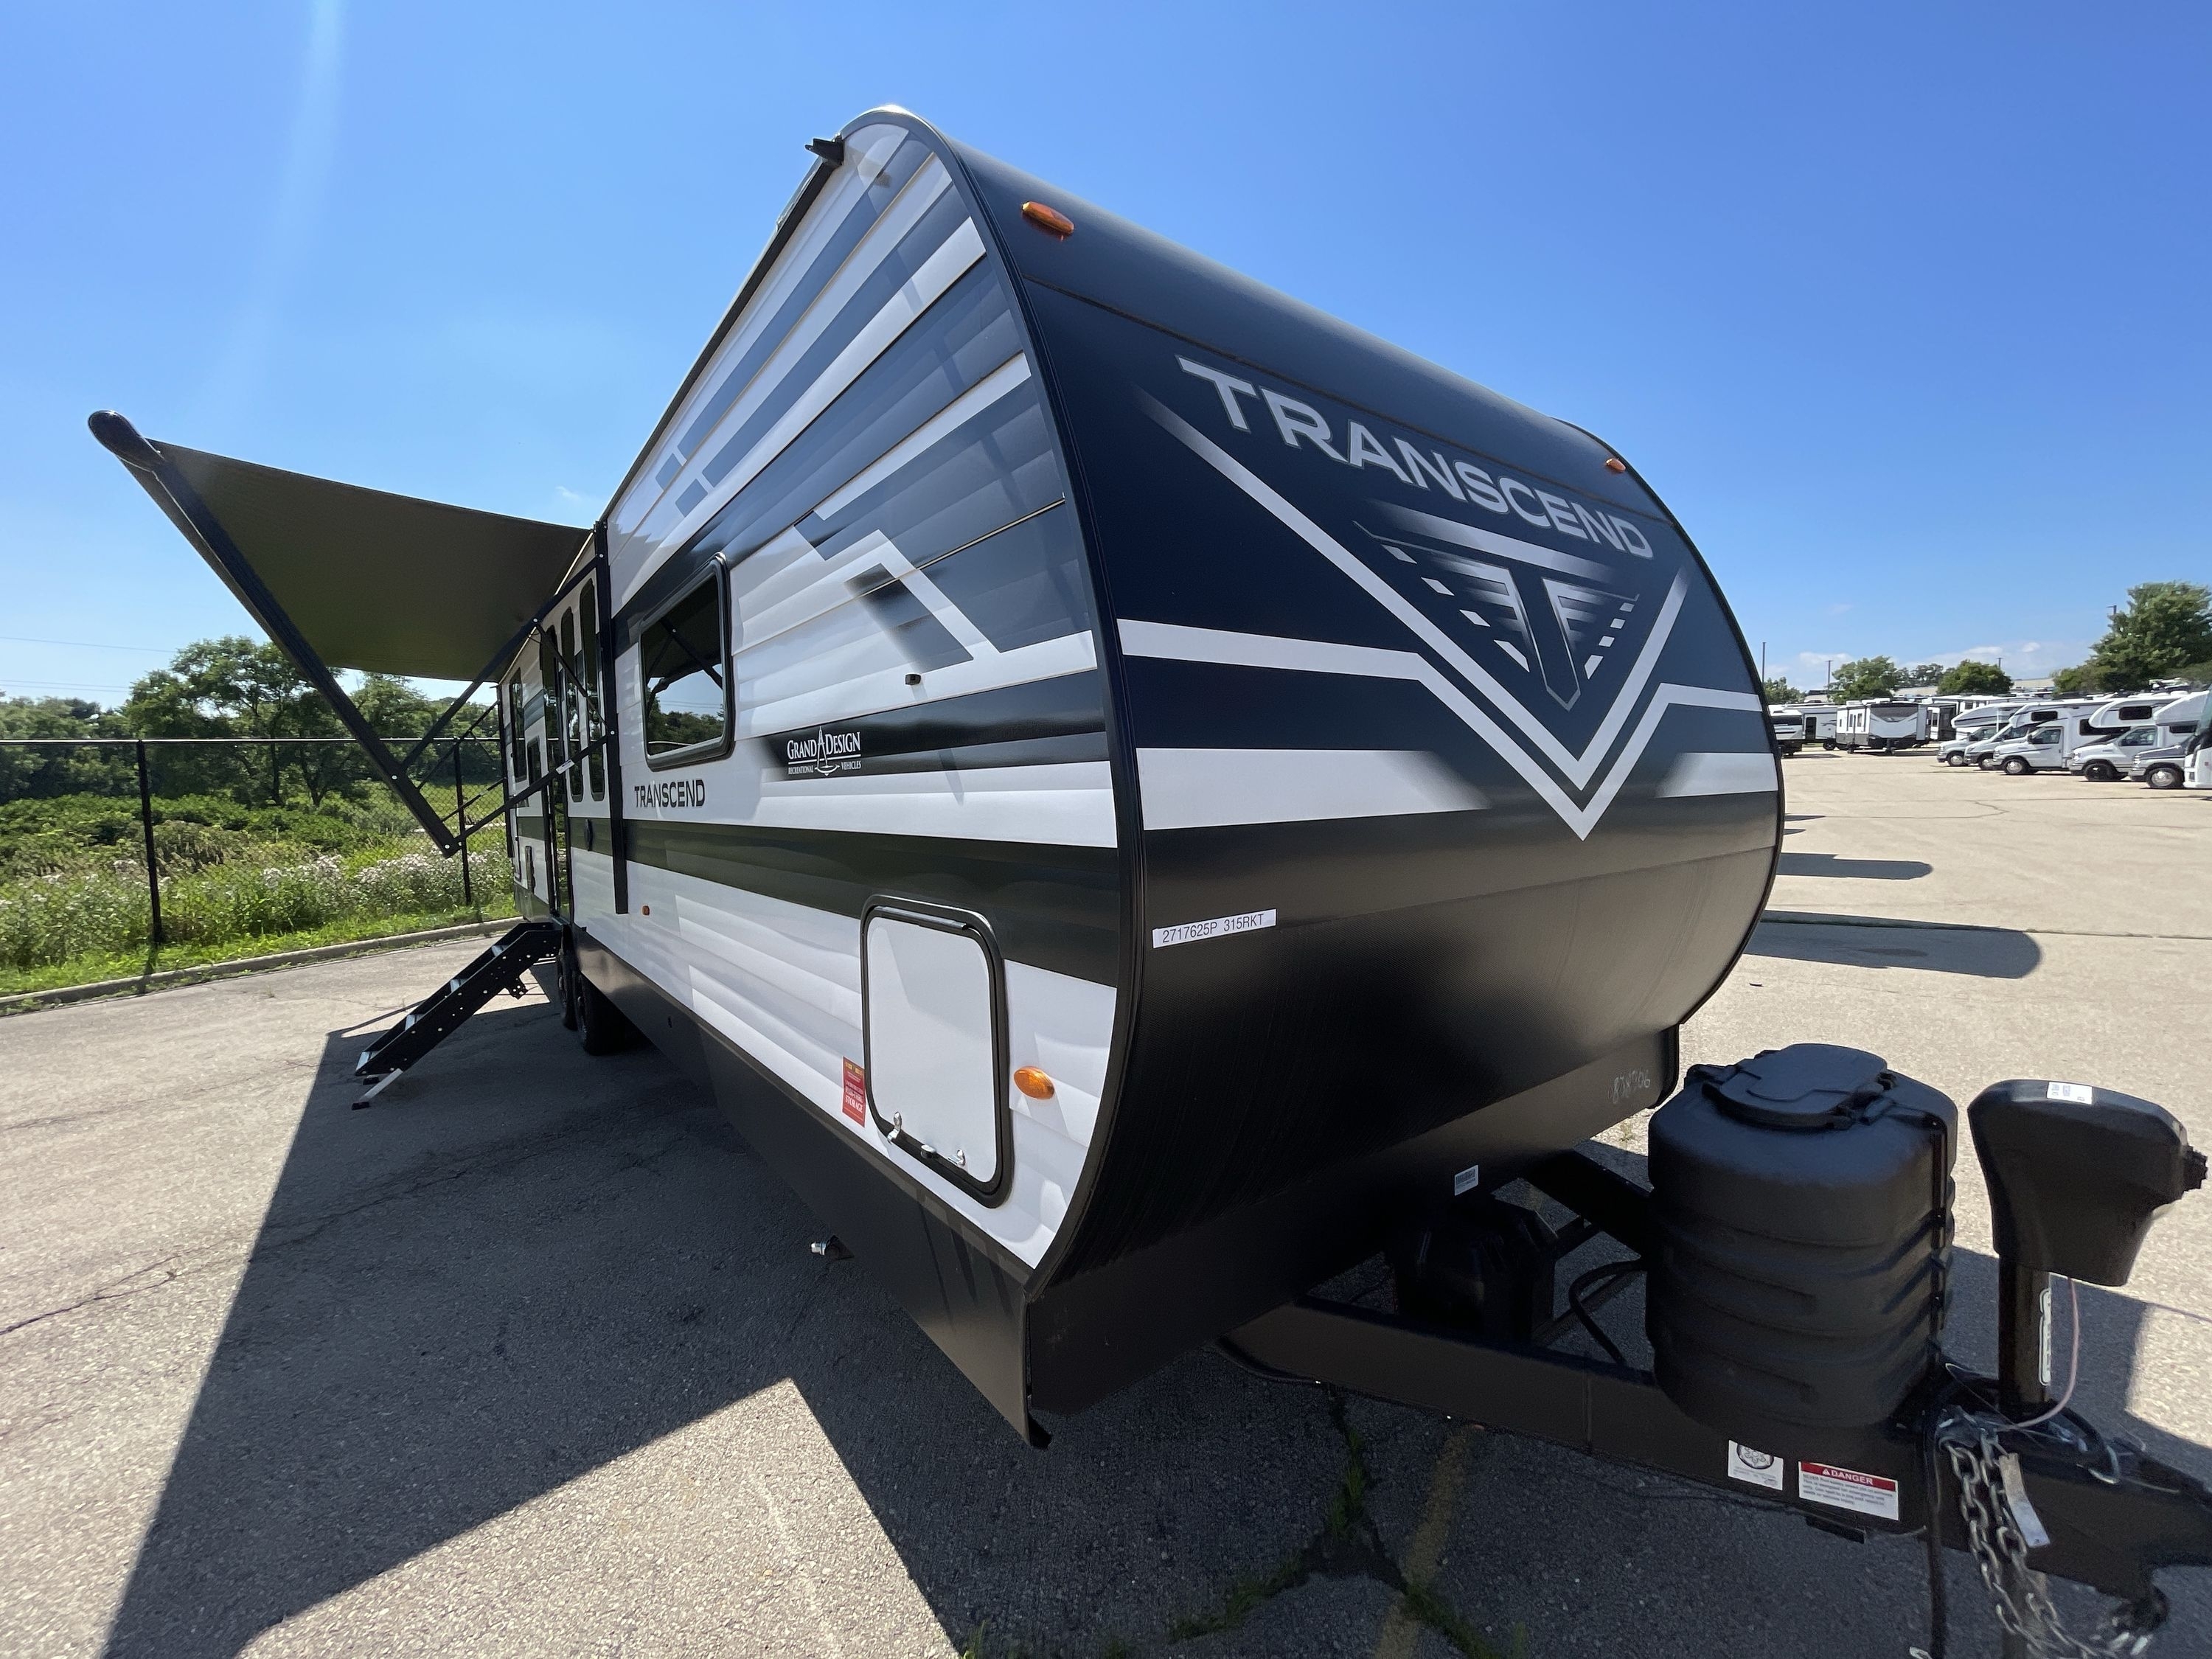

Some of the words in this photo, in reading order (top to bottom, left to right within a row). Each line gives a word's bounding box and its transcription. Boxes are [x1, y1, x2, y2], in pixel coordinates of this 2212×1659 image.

[1175, 355, 1654, 560] TRANSCEND
[787, 740, 817, 759] GRAND
[825, 731, 861, 755] DESIGN
[841, 760, 861, 771] VEHICLES
[634, 779, 706, 808] TRANSCEND
[1162, 922, 1217, 944] 2717625P
[1223, 914, 1265, 932] 315RKT
[845, 1095, 863, 1113] STORAGE
[1831, 1470, 1874, 1486] DANGER
